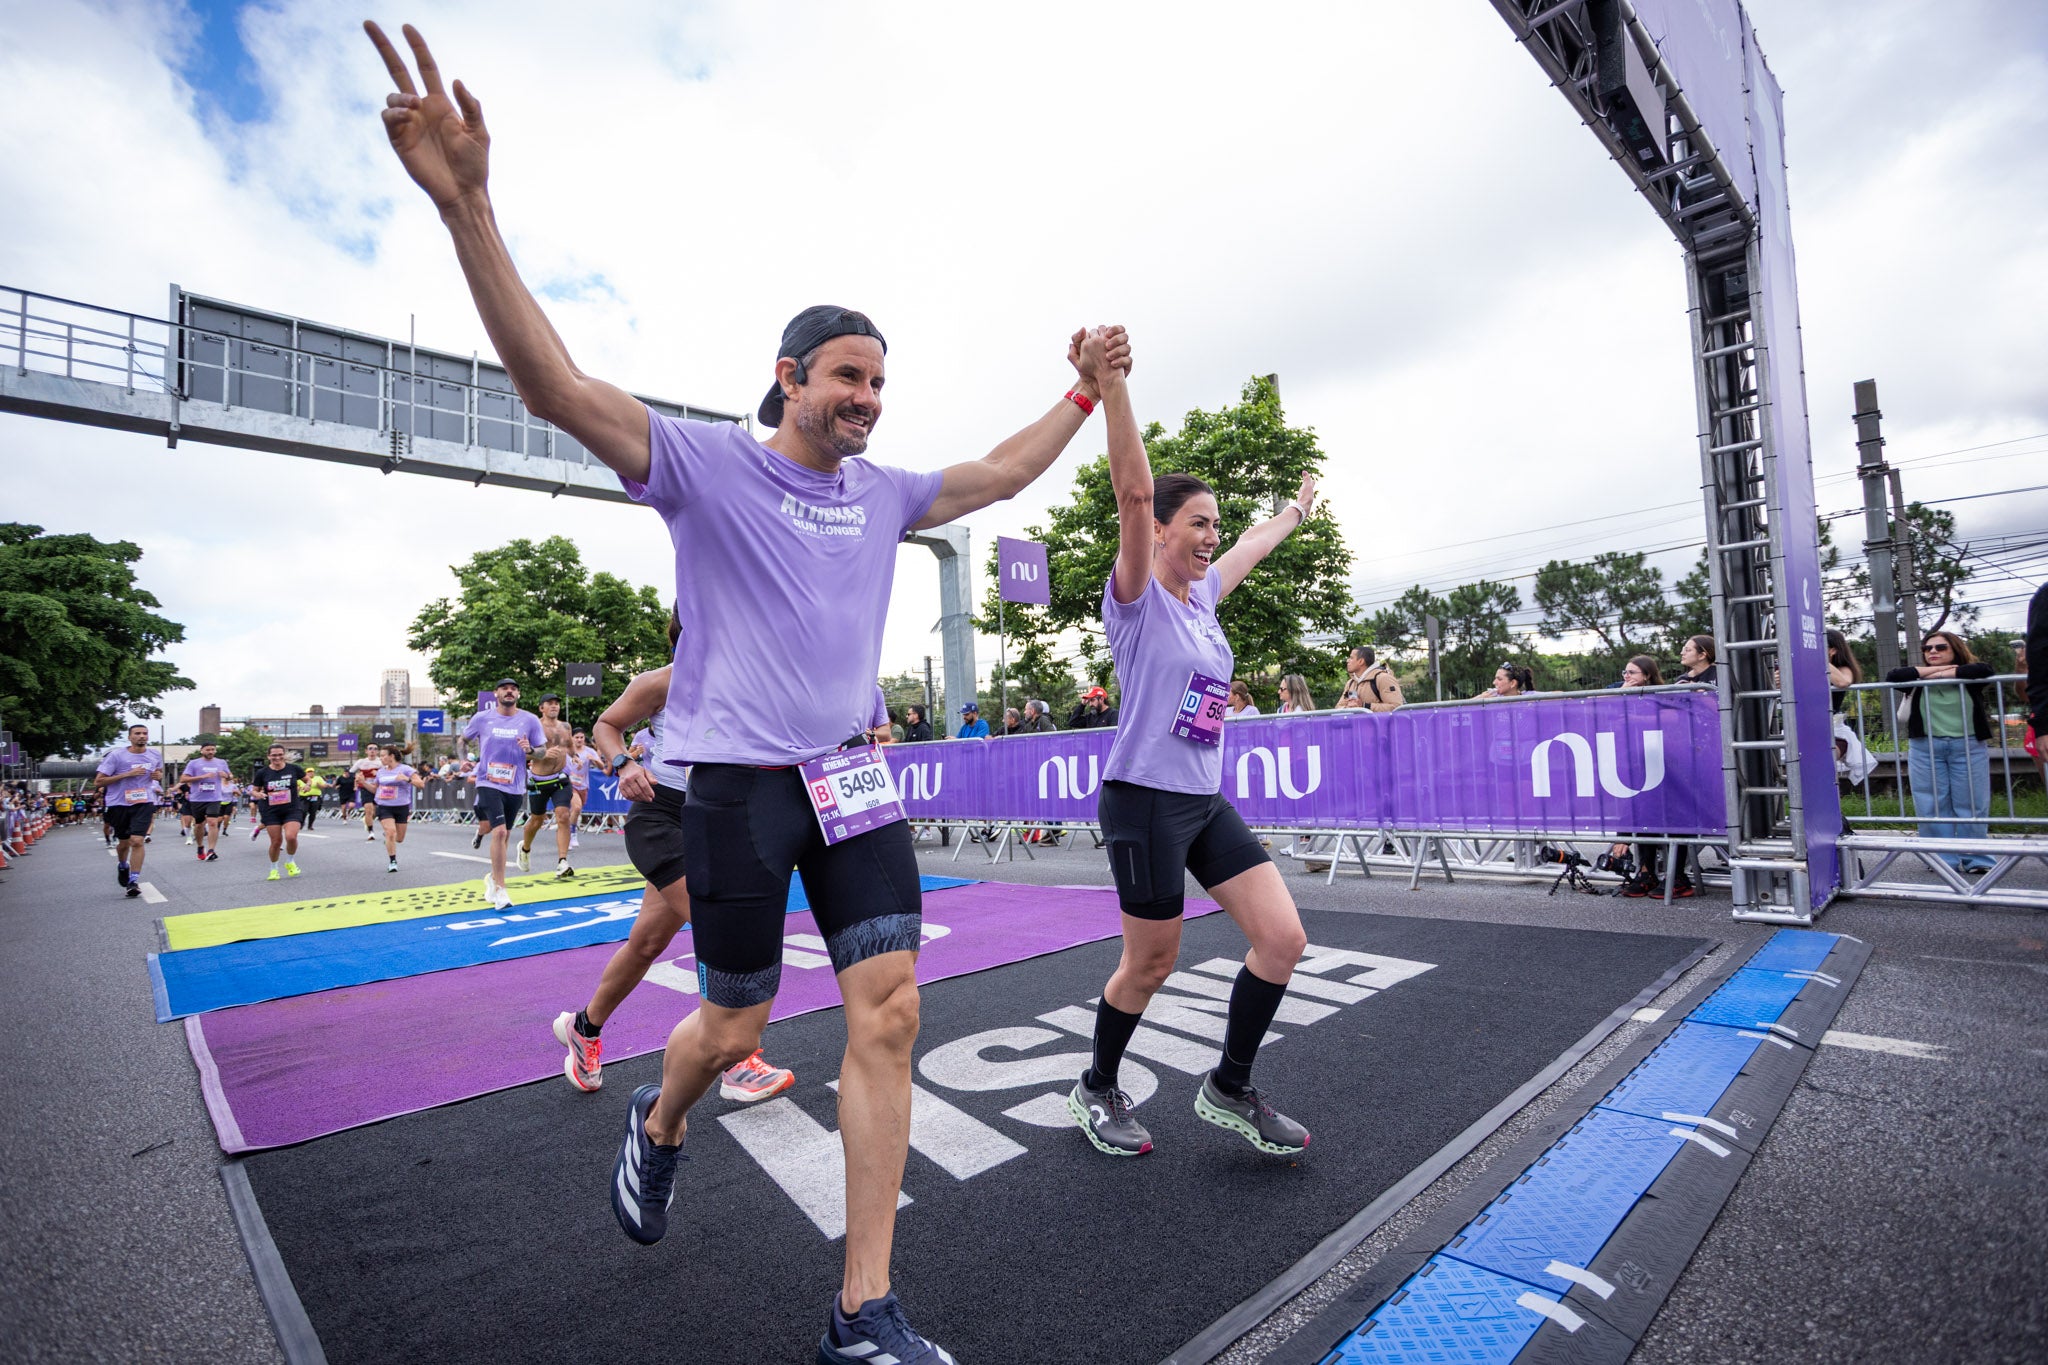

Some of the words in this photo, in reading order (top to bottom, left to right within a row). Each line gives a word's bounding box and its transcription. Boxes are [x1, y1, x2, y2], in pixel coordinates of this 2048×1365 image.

[793, 518, 817, 533] RUN
[820, 525, 862, 536] LONGER
[1011, 561, 1038, 582] nu
[572, 674, 596, 686] rvb
[1186, 694, 1197, 708] D
[1178, 713, 1194, 724] 21.1K
[375, 731, 391, 739] rvb
[822, 757, 851, 772] ATHENAS
[1236, 745, 1322, 799] nu
[1531, 730, 1665, 799] nu
[839, 767, 886, 799] 5490
[899, 763, 943, 800] nu
[1038, 755, 1098, 800] nu
[815, 785, 829, 803] B
[865, 799, 880, 808] IGOR
[821, 809, 841, 822] 21.1K
[718, 944, 1437, 1240] FINISH
